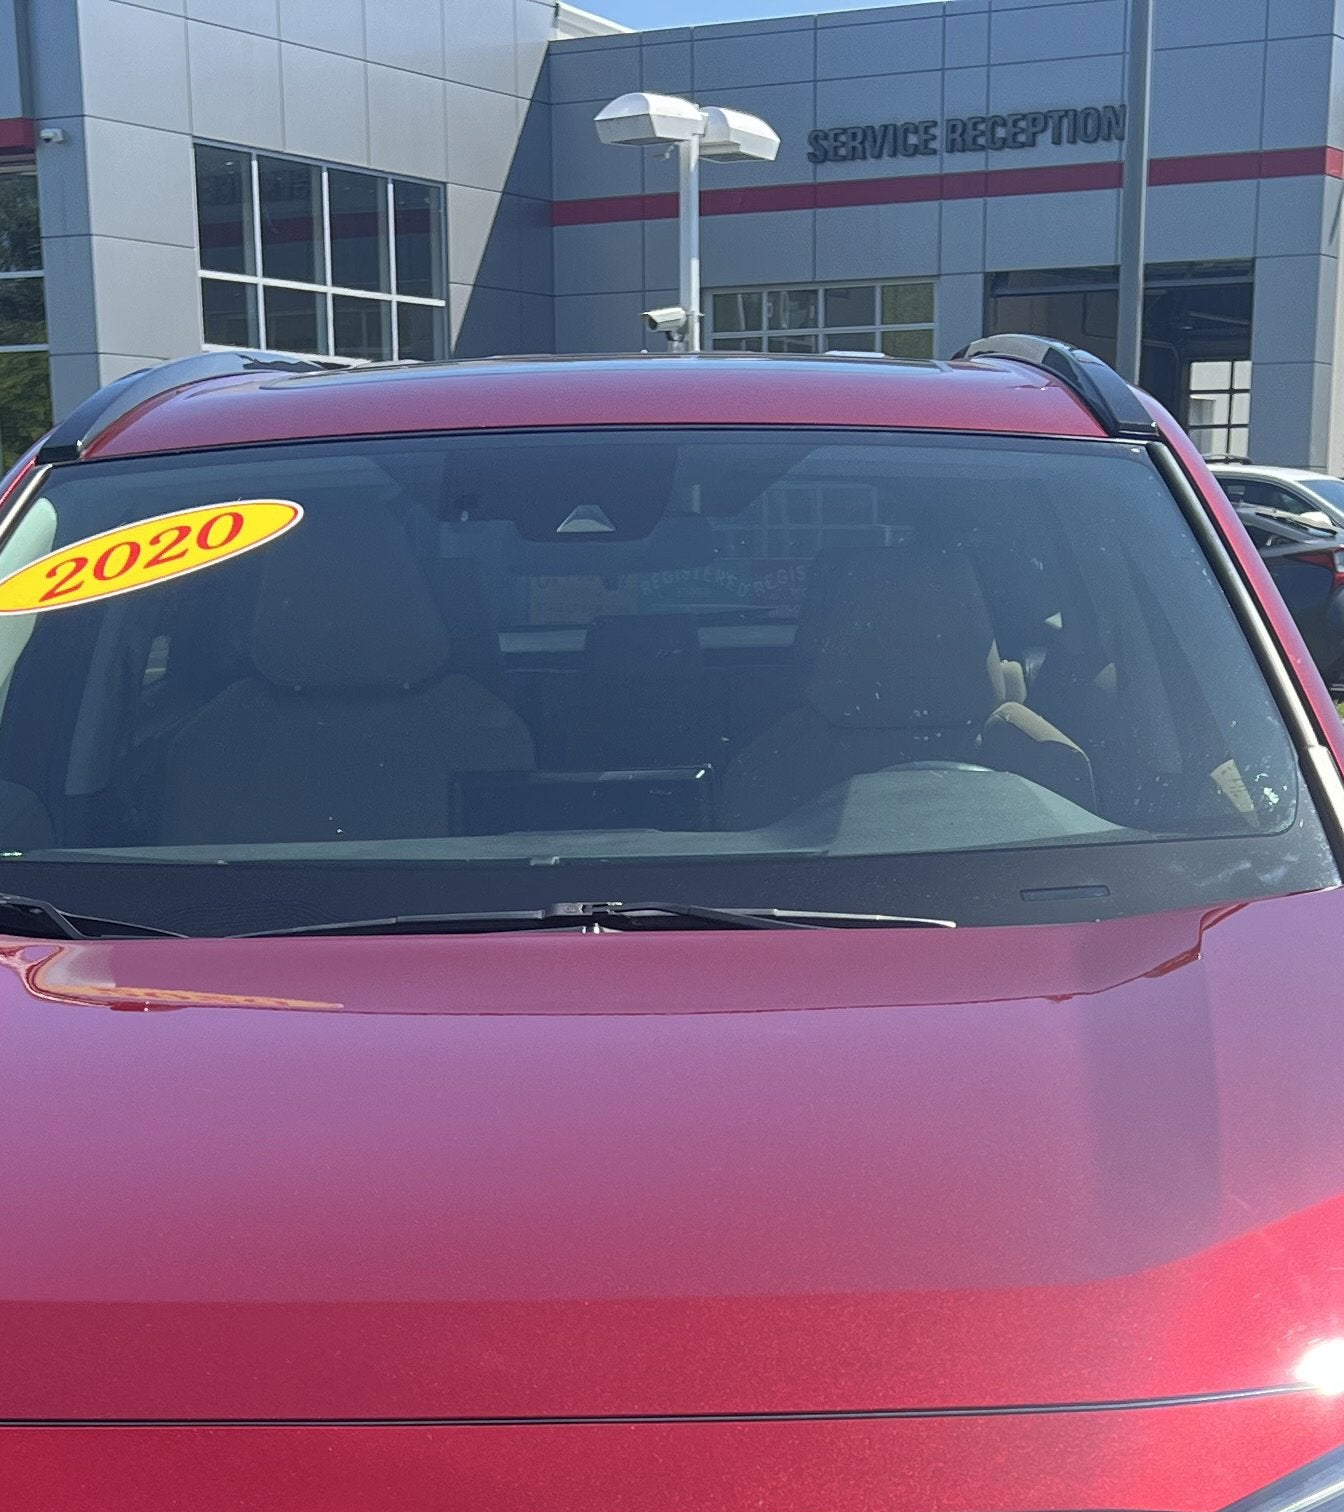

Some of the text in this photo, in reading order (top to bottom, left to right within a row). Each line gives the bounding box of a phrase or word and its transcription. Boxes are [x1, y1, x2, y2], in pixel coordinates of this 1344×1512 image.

[807, 105, 1126, 164] SERVICE RECEPTION
[39, 512, 244, 602] 2020
[753, 566, 807, 594] REGIS
